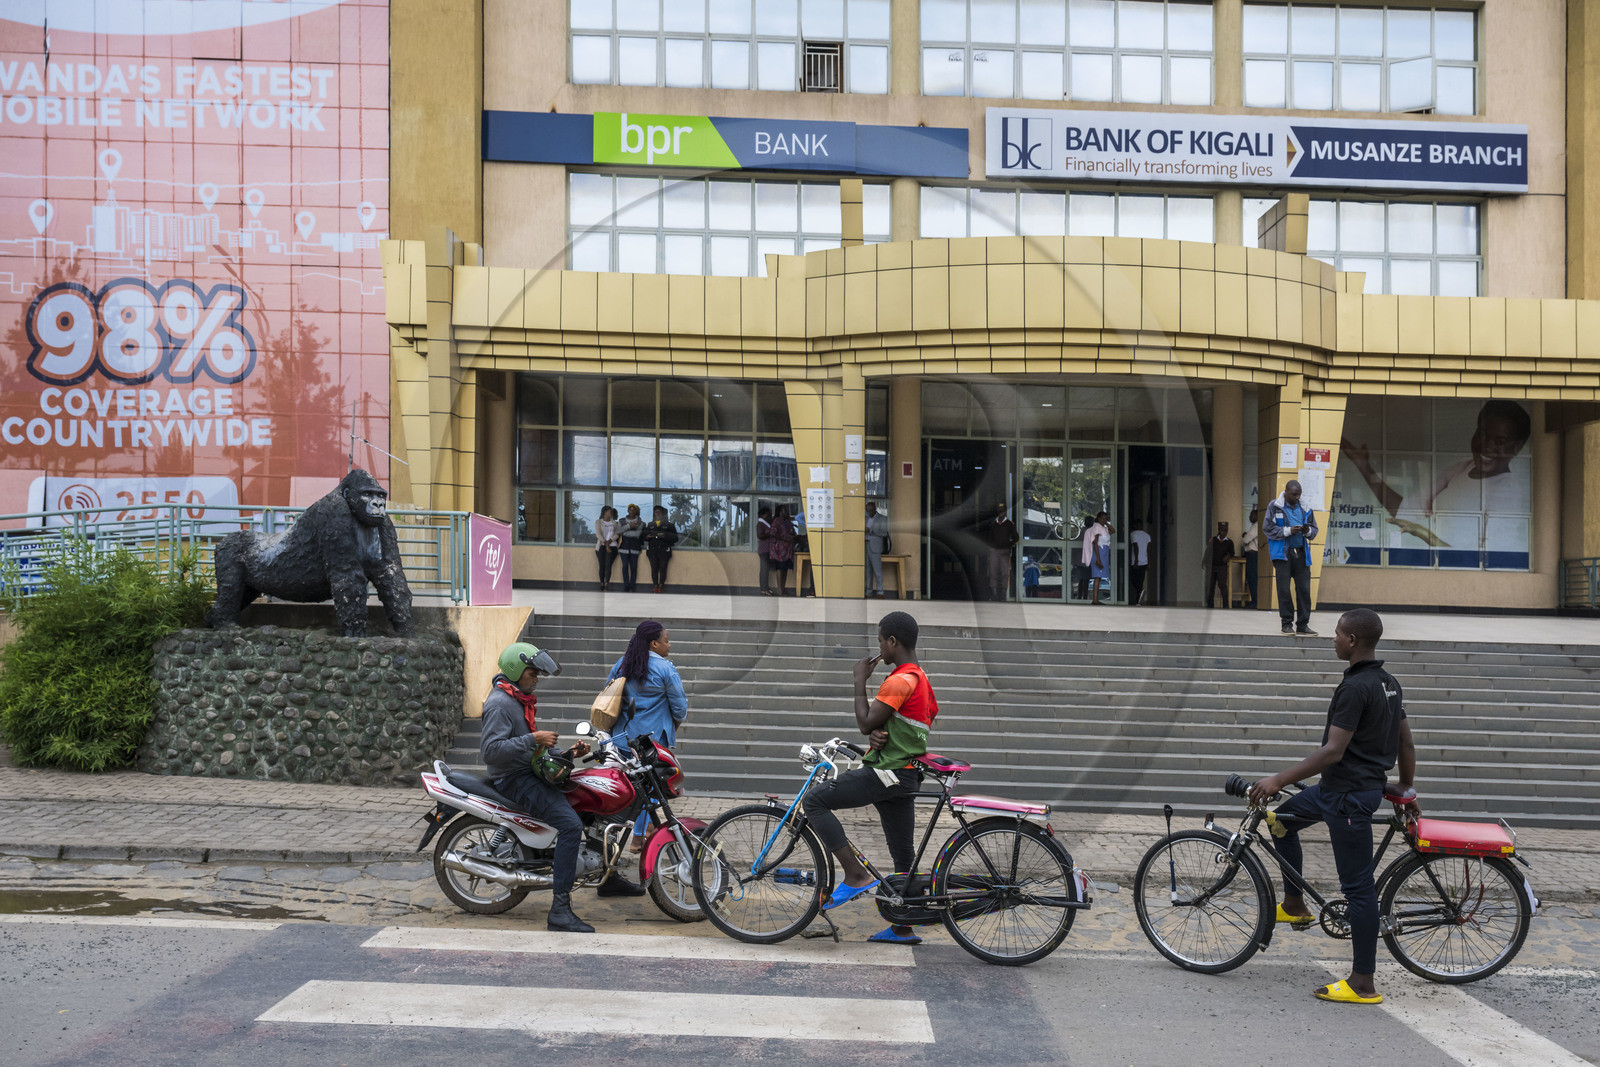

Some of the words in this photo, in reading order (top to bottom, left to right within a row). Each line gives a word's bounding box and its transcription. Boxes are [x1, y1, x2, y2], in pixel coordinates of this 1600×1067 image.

[176, 66, 334, 98] FASTEST
[0, 94, 122, 127] OBILE
[136, 97, 326, 132] NETWORK
[620, 113, 693, 165] bpr
[755, 132, 829, 156] BANK
[1065, 126, 1141, 153] BANK
[1147, 129, 1183, 153] OF
[1190, 131, 1273, 157] KIGALI
[1310, 140, 1422, 163] MUSANZE
[1429, 144, 1522, 167] BRANCH
[1065, 157, 1141, 177] Financially
[1144, 159, 1238, 179] transforming
[1241, 163, 1273, 177] lives
[33, 286, 249, 378] 98%
[40, 387, 234, 417] COVERAGE
[1, 416, 273, 447] COUNTRYWIDE
[933, 458, 963, 472] ATM
[115, 489, 206, 522] 2550
[1339, 504, 1374, 516] Kigali
[1328, 520, 1373, 529] usanze
[485, 541, 500, 569] itel
